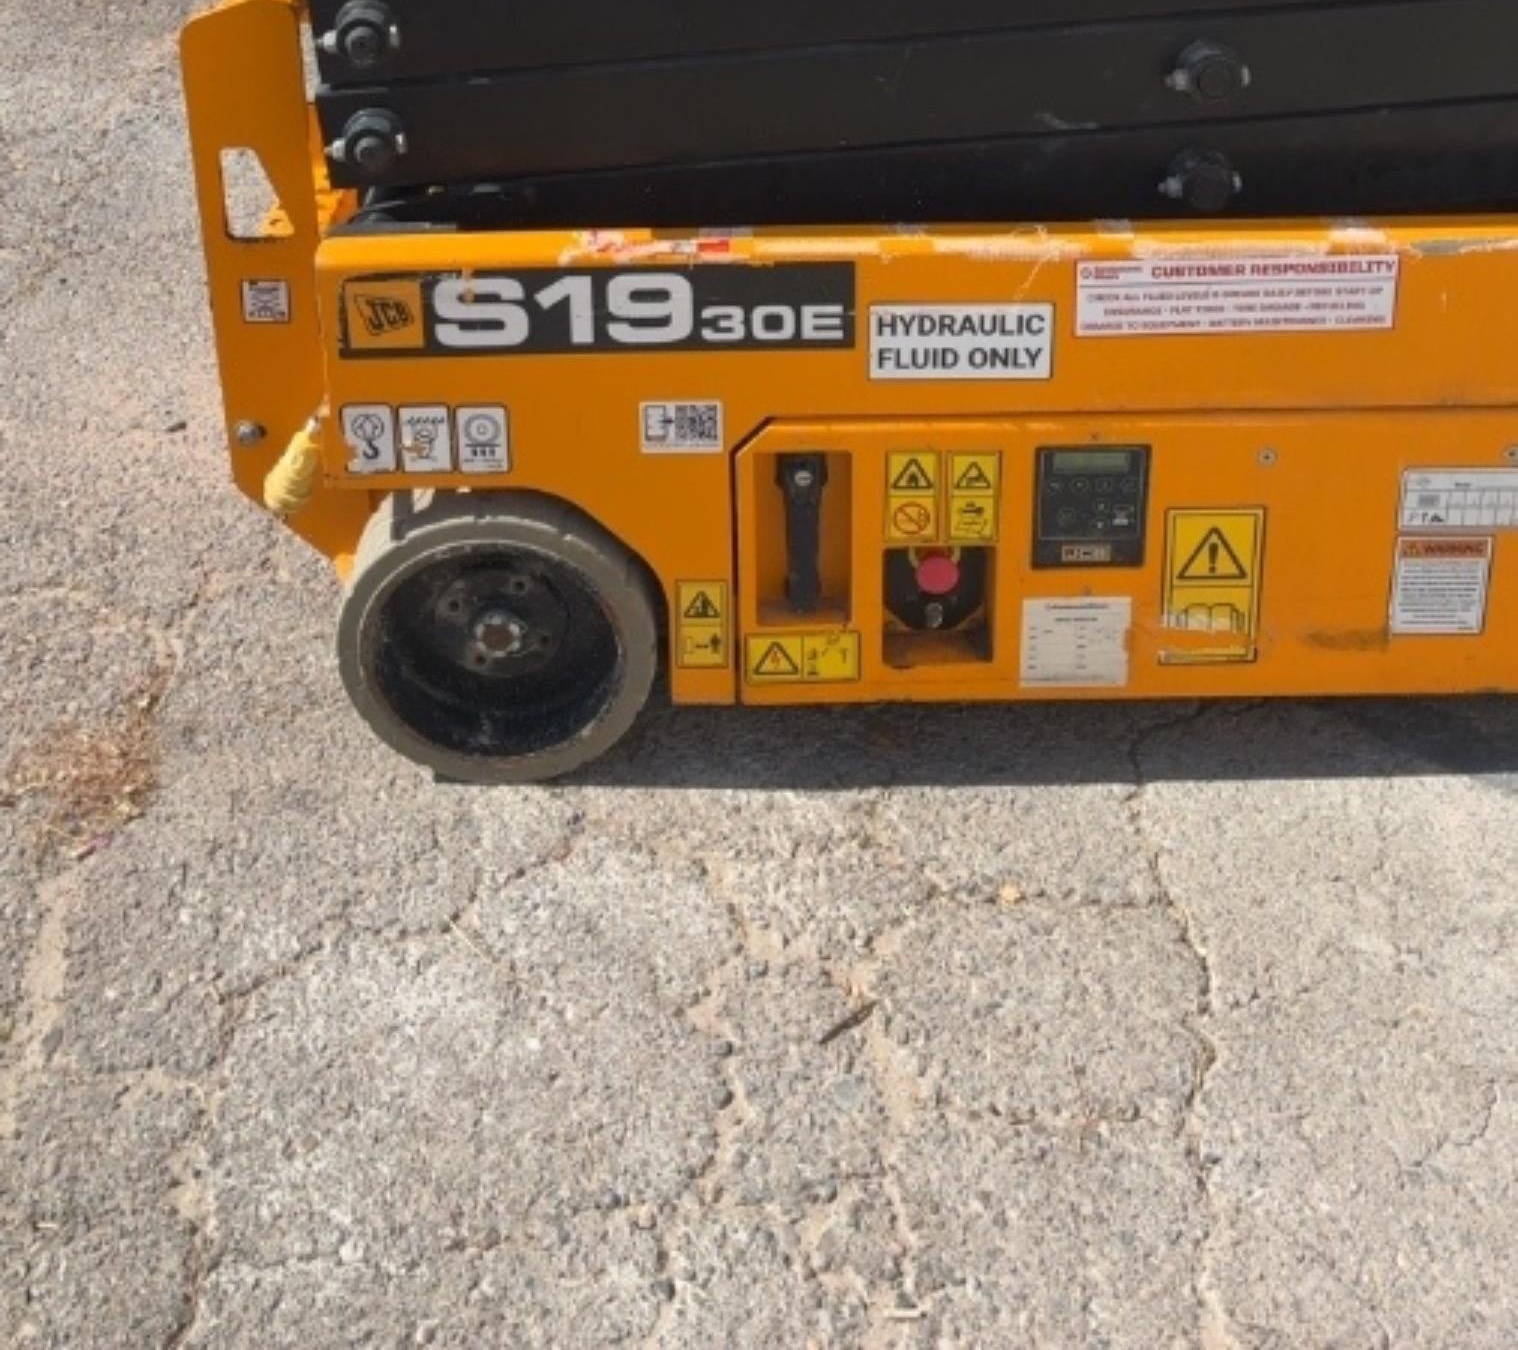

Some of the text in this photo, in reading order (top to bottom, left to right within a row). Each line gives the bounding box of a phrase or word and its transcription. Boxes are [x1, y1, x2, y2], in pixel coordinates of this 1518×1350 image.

[1151, 261, 1246, 279] CUSTOMER
[1250, 260, 1396, 276] RESPONSIBILITY
[876, 314, 1046, 337] HYDRAULIC
[877, 347, 1043, 370] FLUID ONLY
